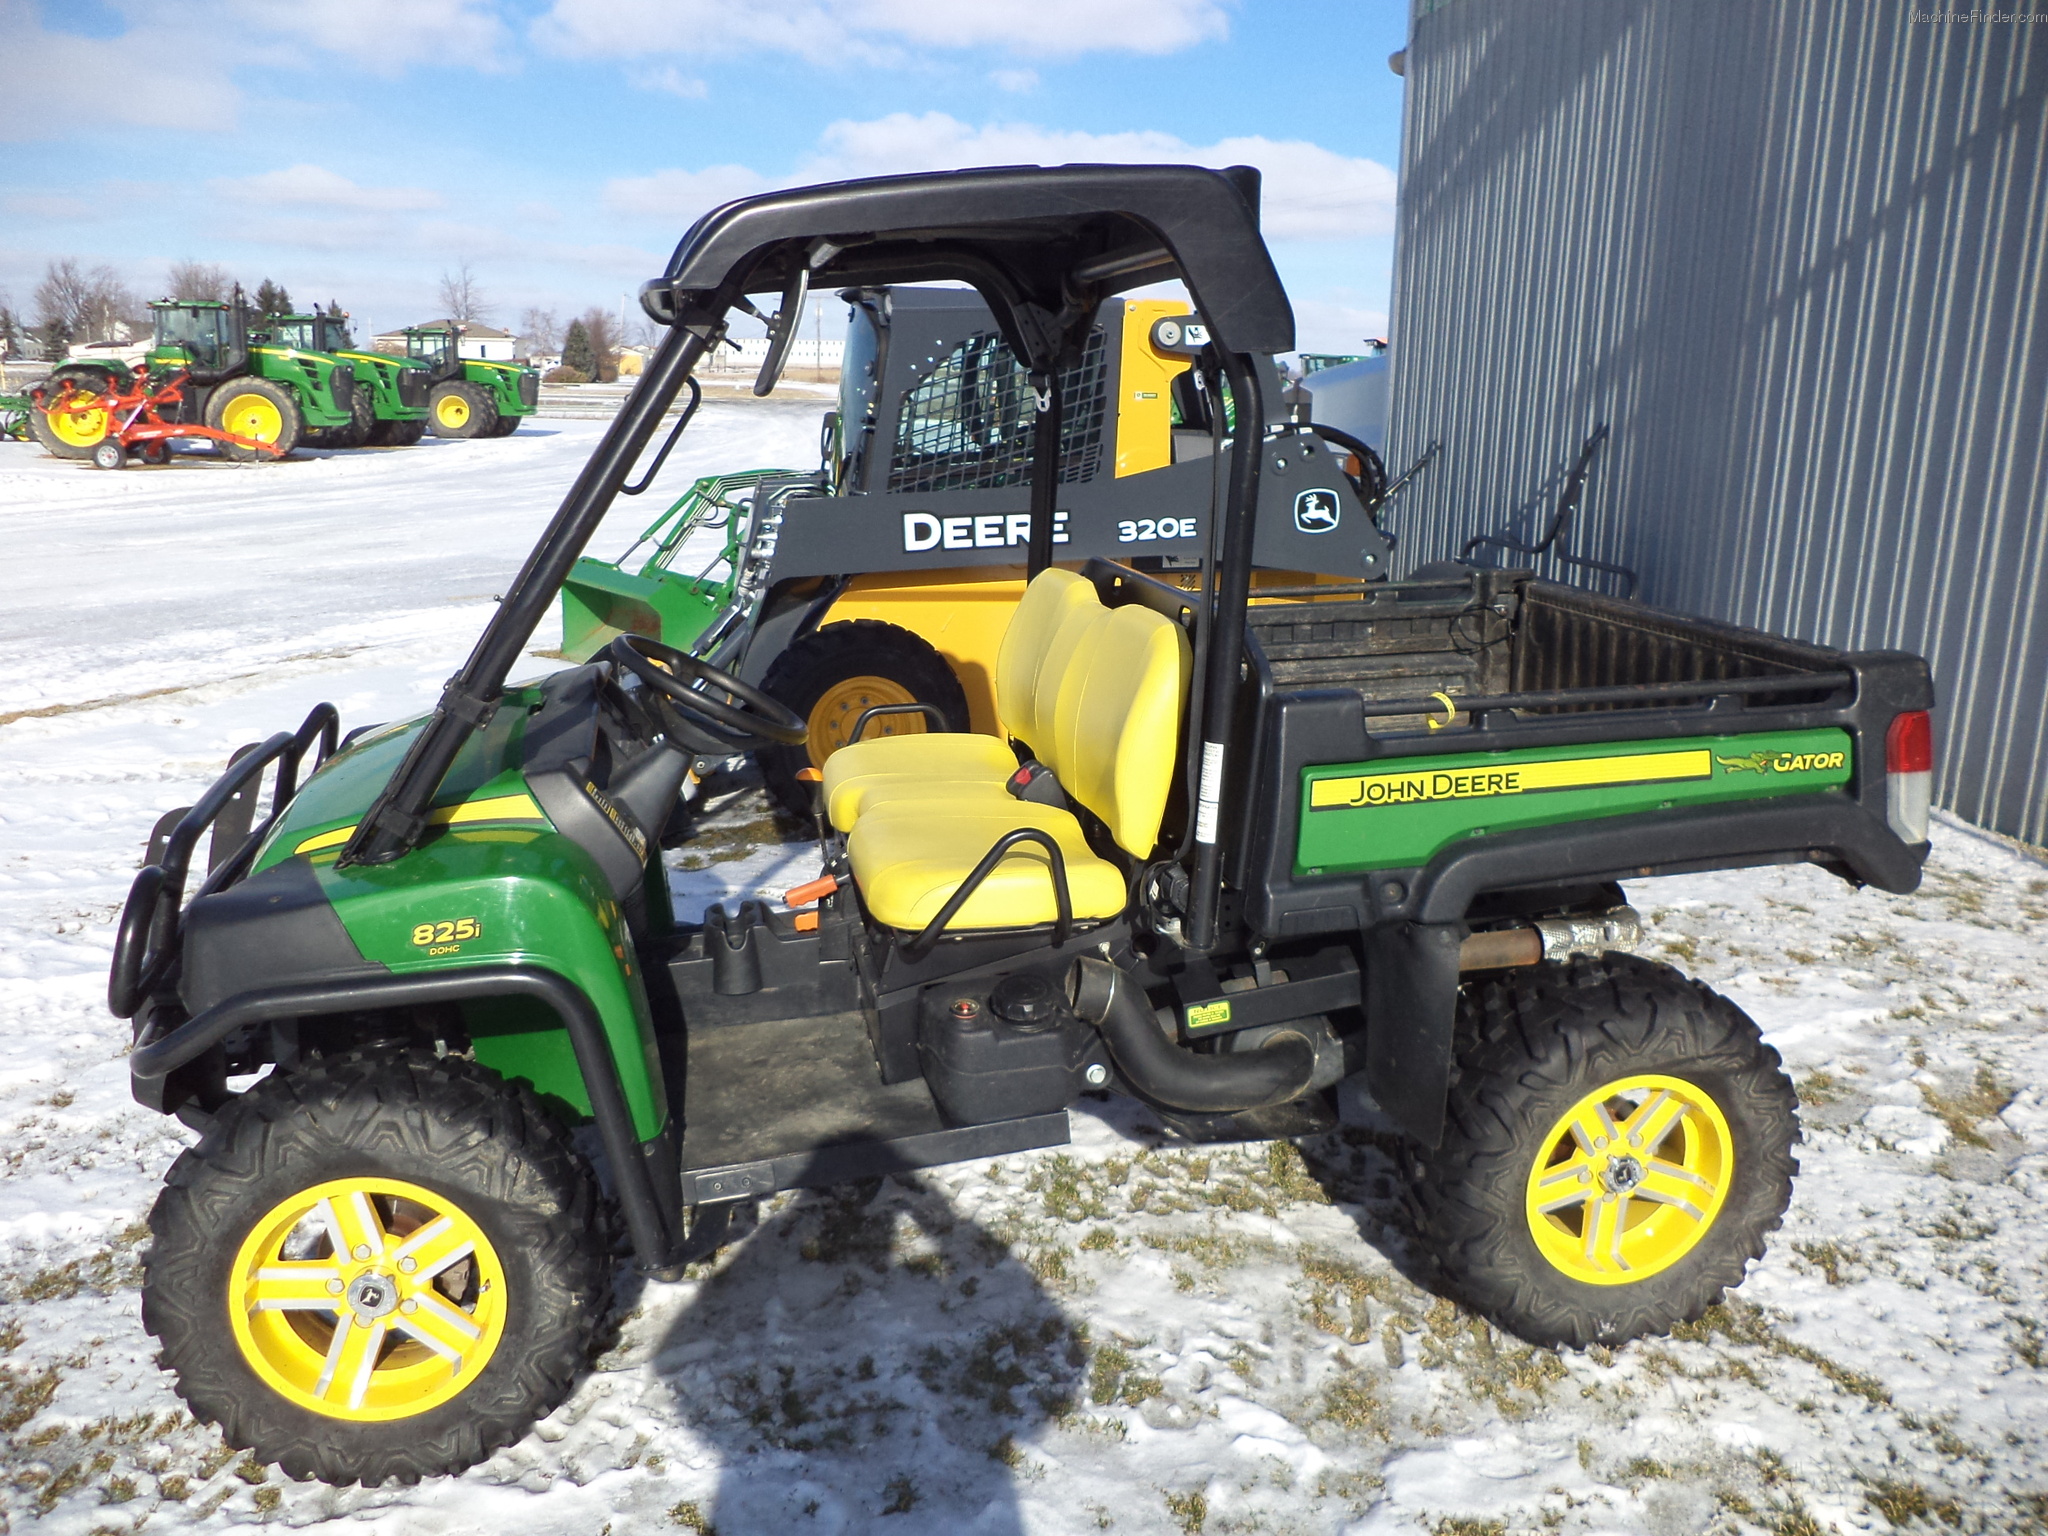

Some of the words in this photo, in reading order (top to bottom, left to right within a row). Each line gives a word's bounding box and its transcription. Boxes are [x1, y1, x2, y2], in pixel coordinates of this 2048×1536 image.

[1118, 517, 1197, 542] 320E
[1773, 752, 1844, 772] GATOR
[1350, 779, 1424, 803] JOHN
[1432, 772, 1519, 796] DEERE
[413, 918, 480, 946] 825i
[429, 944, 460, 956] DOHC
